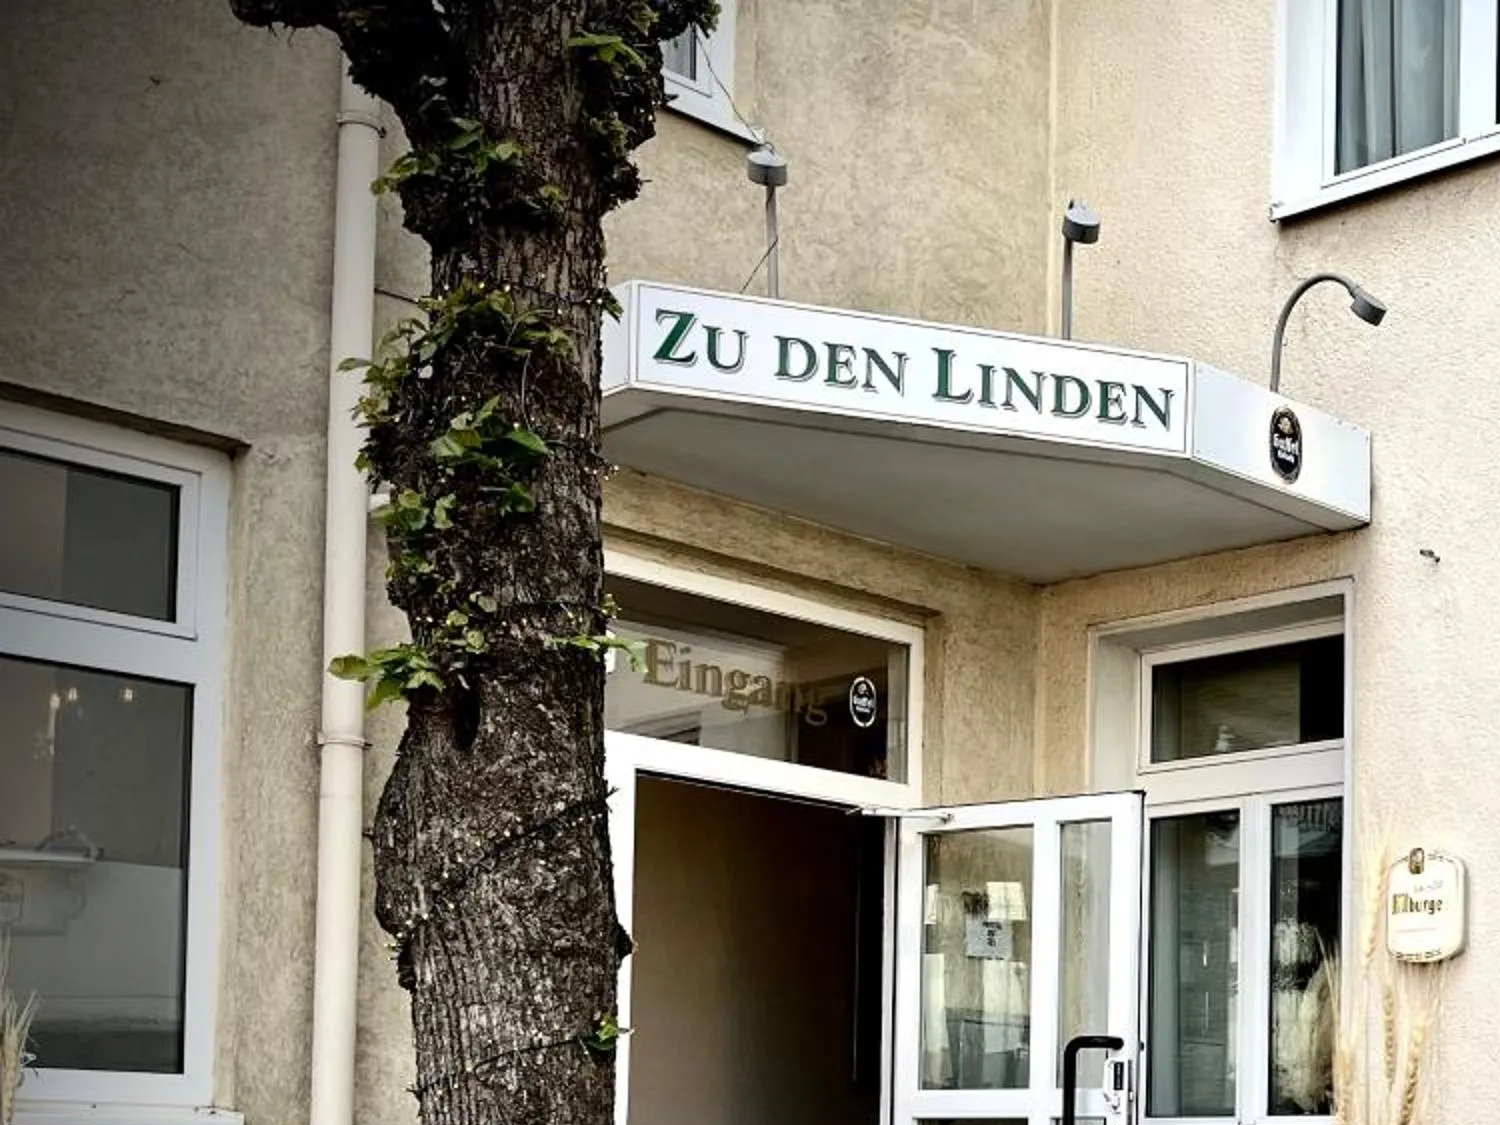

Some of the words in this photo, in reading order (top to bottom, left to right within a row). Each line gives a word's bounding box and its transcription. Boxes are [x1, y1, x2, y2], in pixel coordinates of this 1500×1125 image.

[773, 334, 911, 398] DEN
[931, 347, 1176, 432] LINDEN
[642, 638, 828, 727] Eingang
